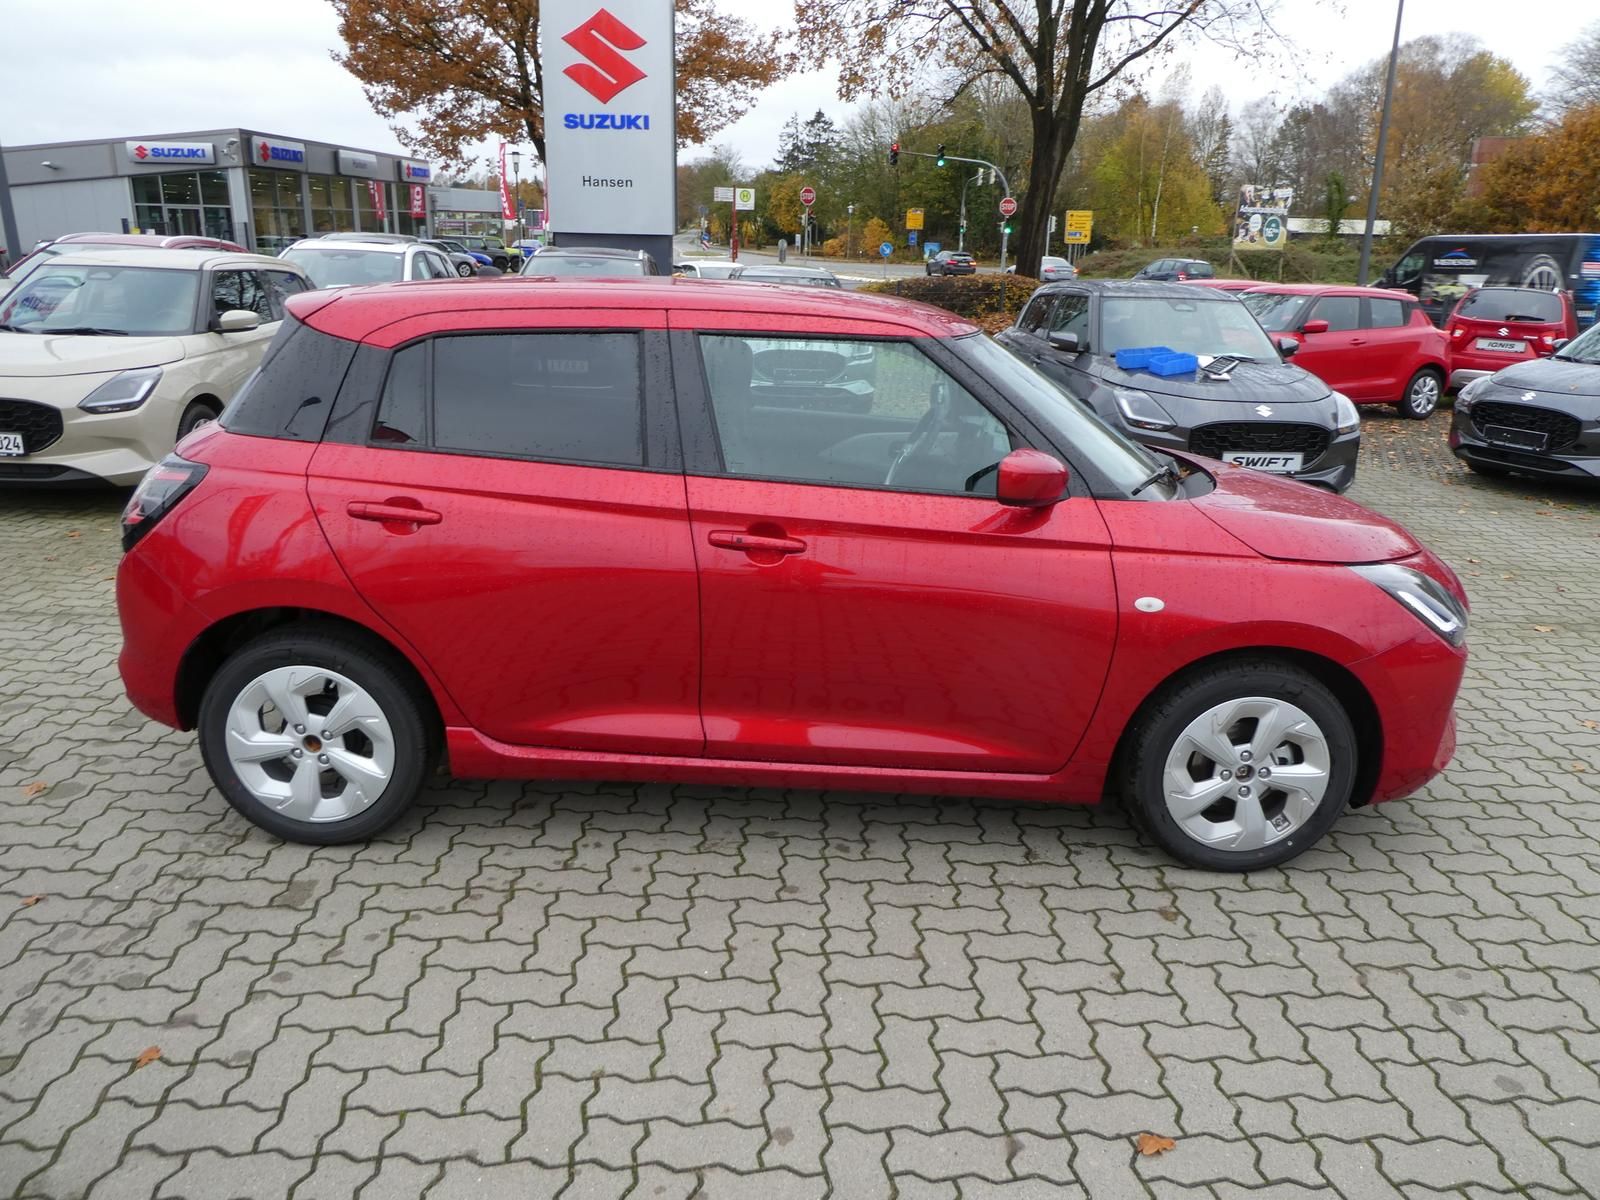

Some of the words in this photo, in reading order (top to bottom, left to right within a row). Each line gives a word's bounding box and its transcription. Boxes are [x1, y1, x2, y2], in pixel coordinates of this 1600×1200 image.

[563, 113, 650, 130] SUZUKI
[151, 147, 206, 159] SUZUKI
[271, 146, 304, 163] SUZUKI
[582, 175, 633, 188] Hansen
[801, 192, 814, 200] STOP
[1487, 341, 1515, 350] IGNIS
[1232, 456, 1294, 468] SWIFT
